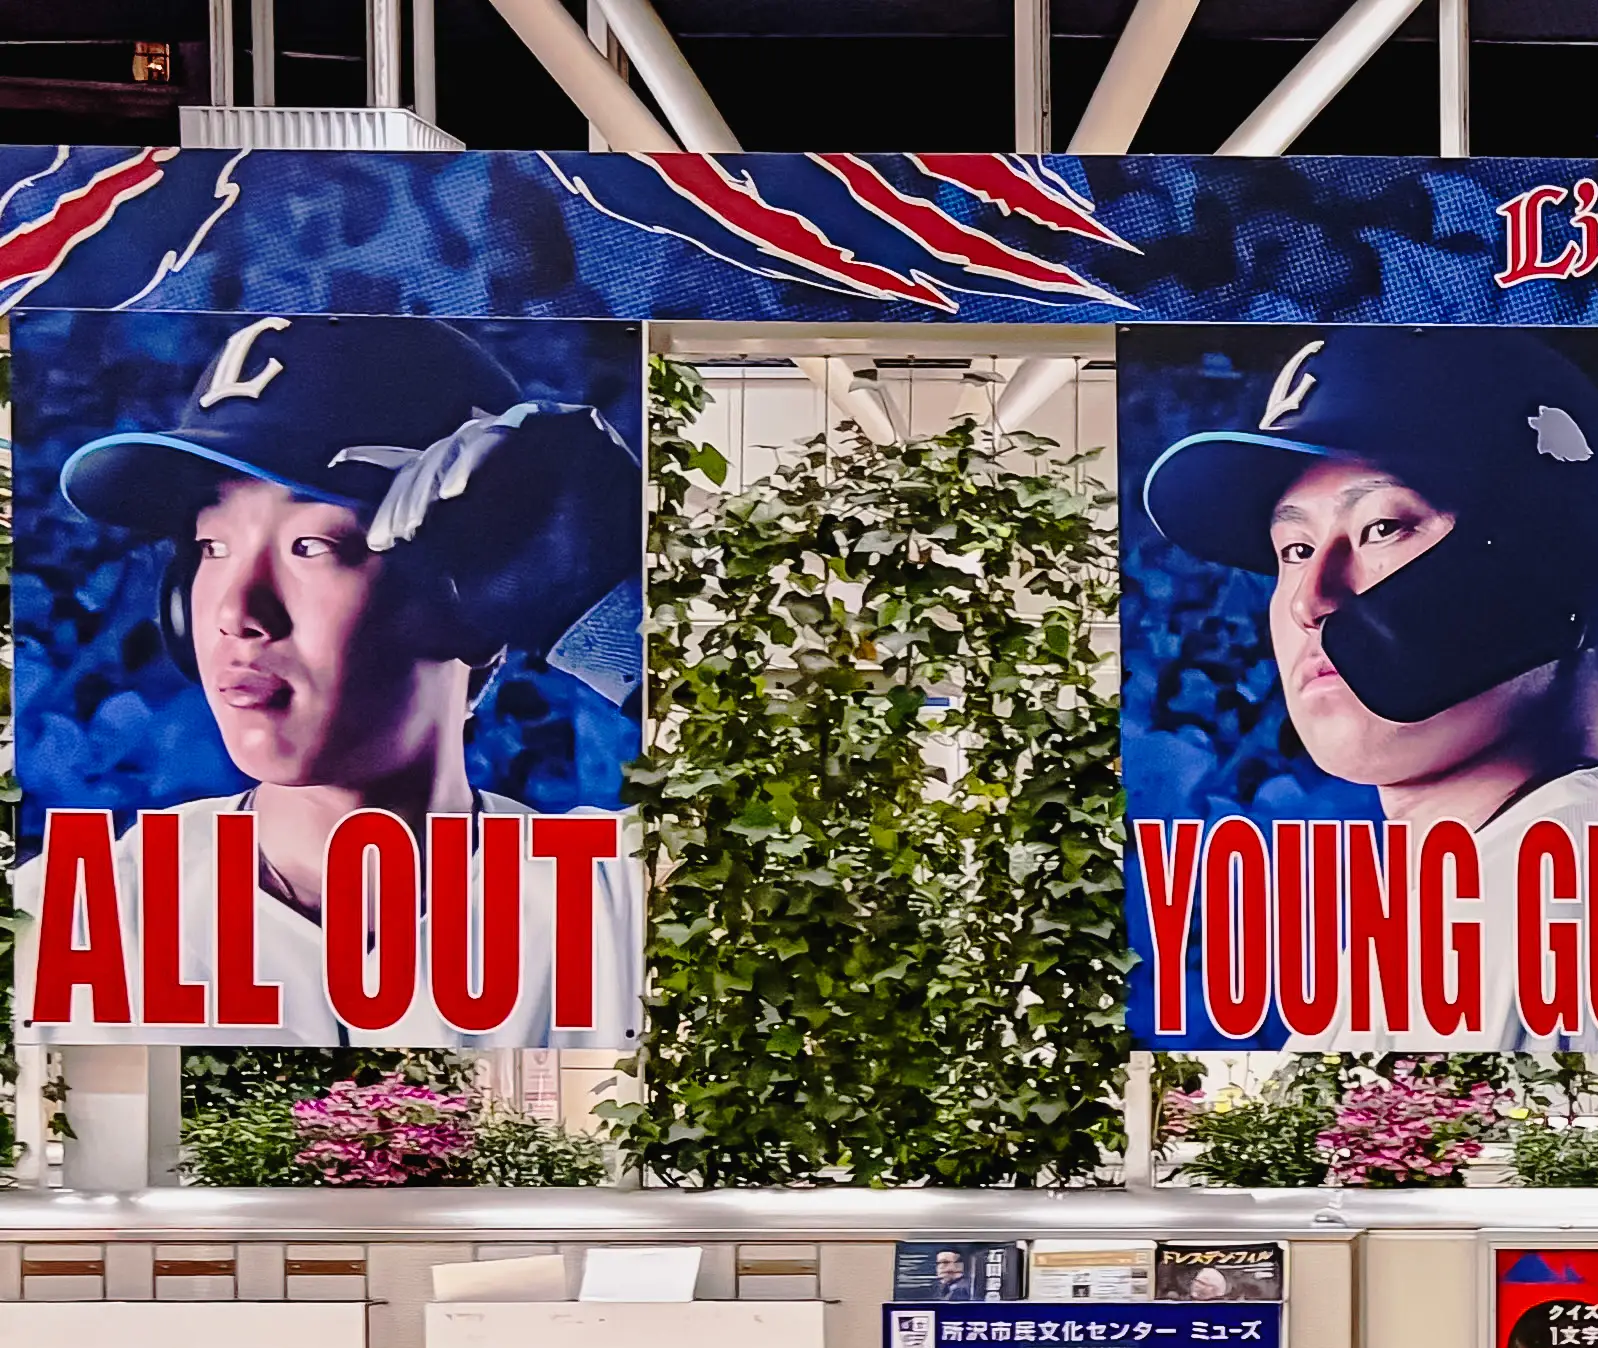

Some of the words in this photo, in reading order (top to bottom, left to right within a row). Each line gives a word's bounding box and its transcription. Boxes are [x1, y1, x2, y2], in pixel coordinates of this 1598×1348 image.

[31, 809, 283, 1028] ALL
[323, 809, 622, 1033] OUT
[1134, 815, 1485, 1038] YOUNG
[941, 1320, 1178, 1342] 所沢市民文化センター
[1190, 1319, 1263, 1341] ミューズ
